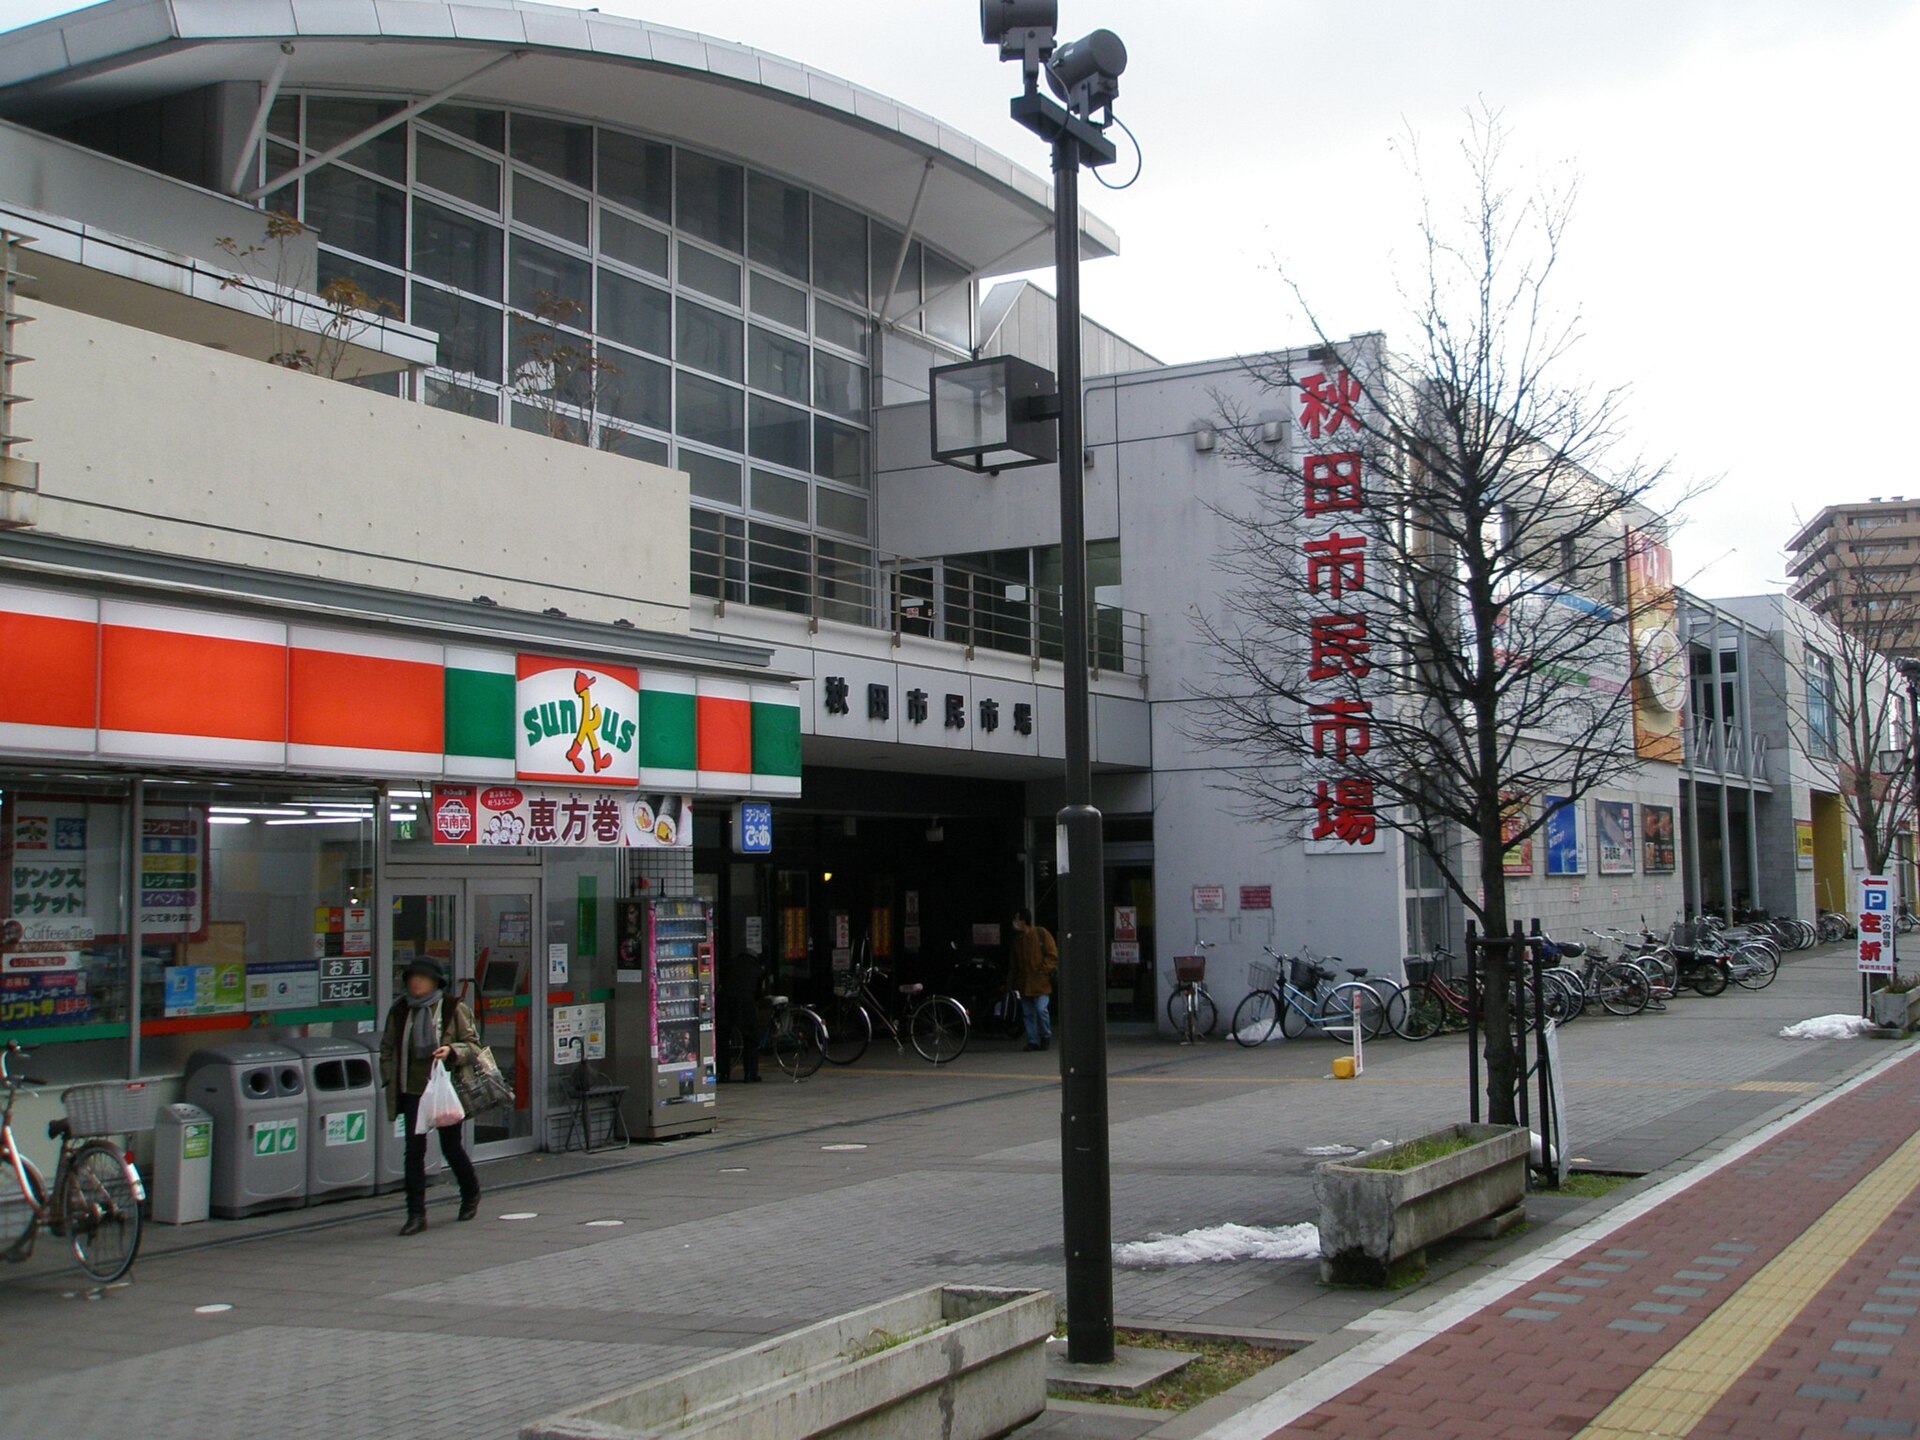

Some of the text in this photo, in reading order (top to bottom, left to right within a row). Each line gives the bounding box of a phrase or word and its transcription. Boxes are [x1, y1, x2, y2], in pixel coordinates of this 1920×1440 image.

[1299, 368, 1376, 846] 秋田市民市場
[825, 676, 1033, 736] 秋田市民市場
[438, 814, 470, 829] 西南西
[527, 797, 621, 842] 恵方巻
[745, 808, 770, 822] チケット
[745, 825, 771, 846] ぴあ
[14, 867, 86, 888] サンクス
[144, 875, 184, 887] レジャー
[14, 892, 82, 914] チケット
[144, 893, 184, 905] イベント
[1869, 893, 1883, 907] P
[1860, 912, 1882, 962] 左折
[329, 959, 364, 976] お酒
[329, 982, 363, 999] たばこ
